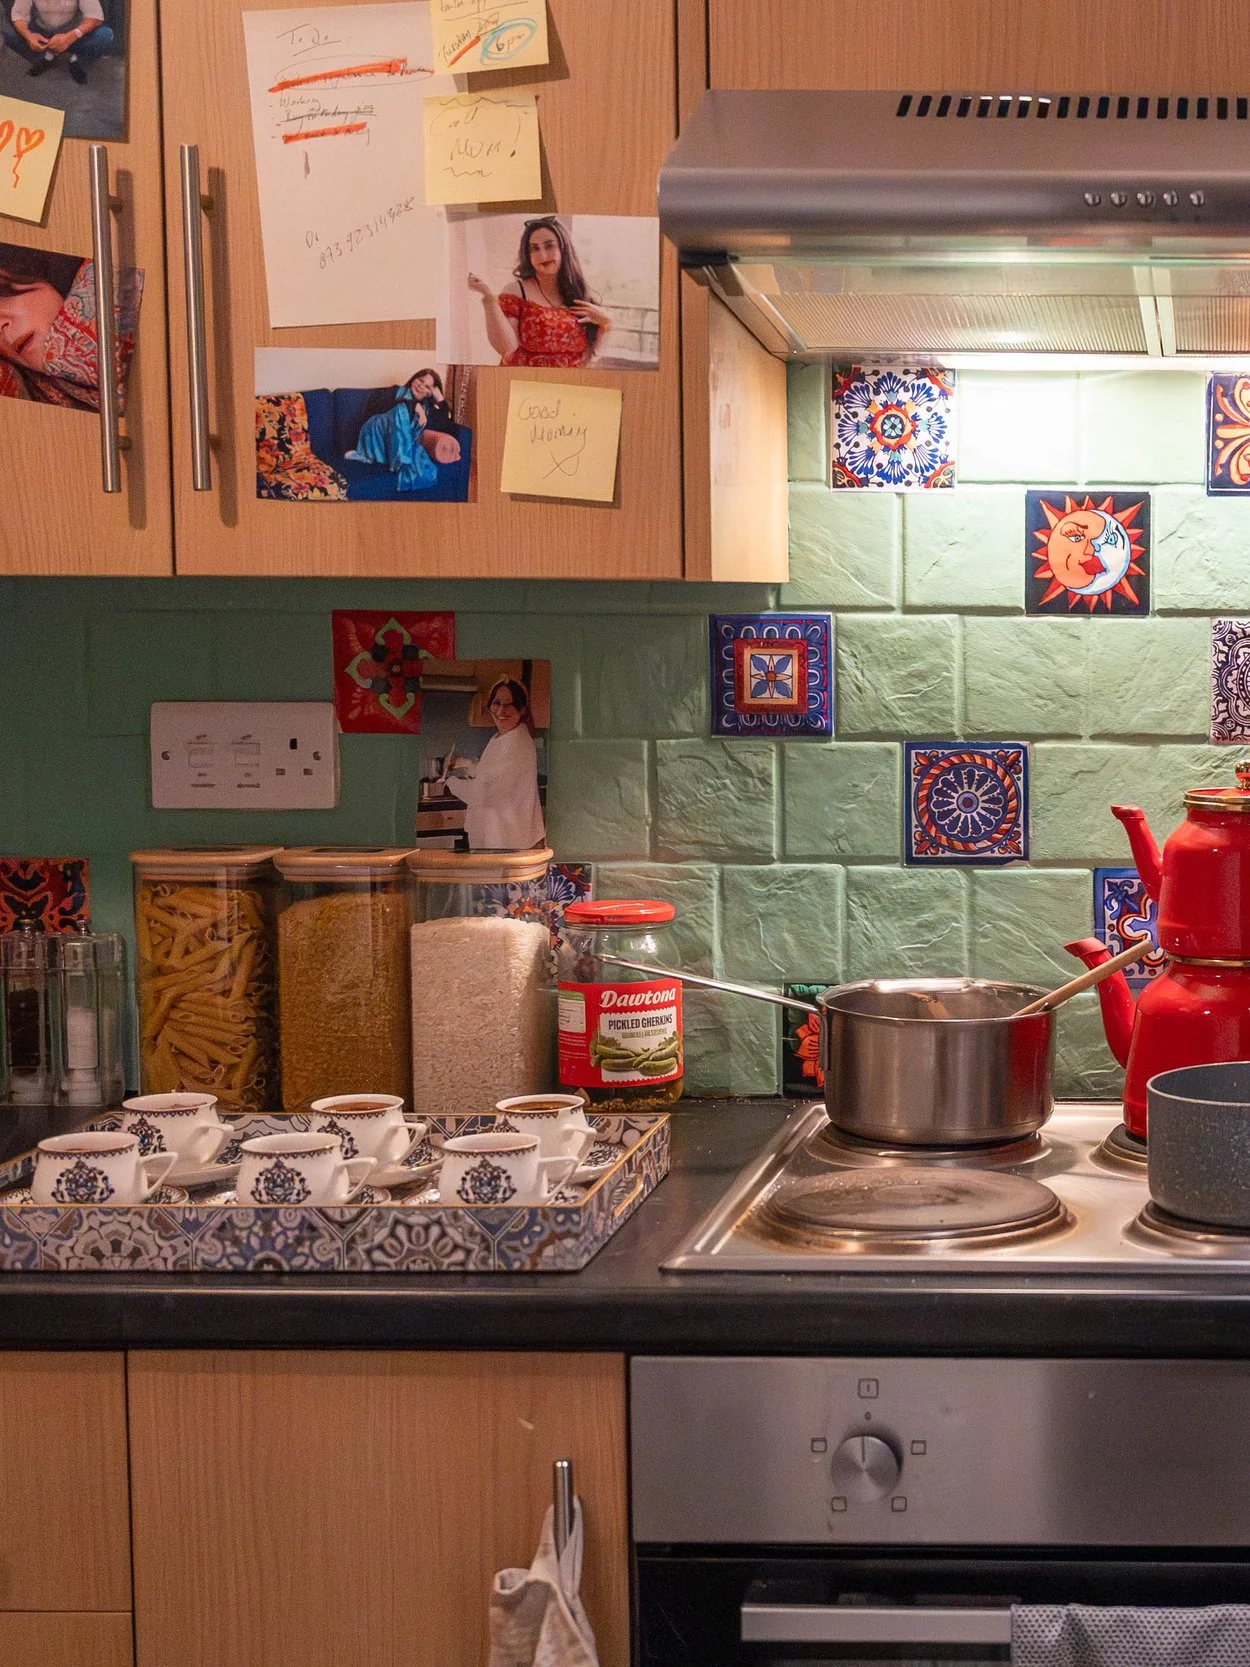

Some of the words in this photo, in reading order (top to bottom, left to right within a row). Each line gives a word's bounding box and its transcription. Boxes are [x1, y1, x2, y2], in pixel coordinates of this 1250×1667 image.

[599, 987, 677, 1008] Dawtona
[608, 1018, 640, 1030] PICKLED
[641, 1014, 673, 1028] GHERKINS
